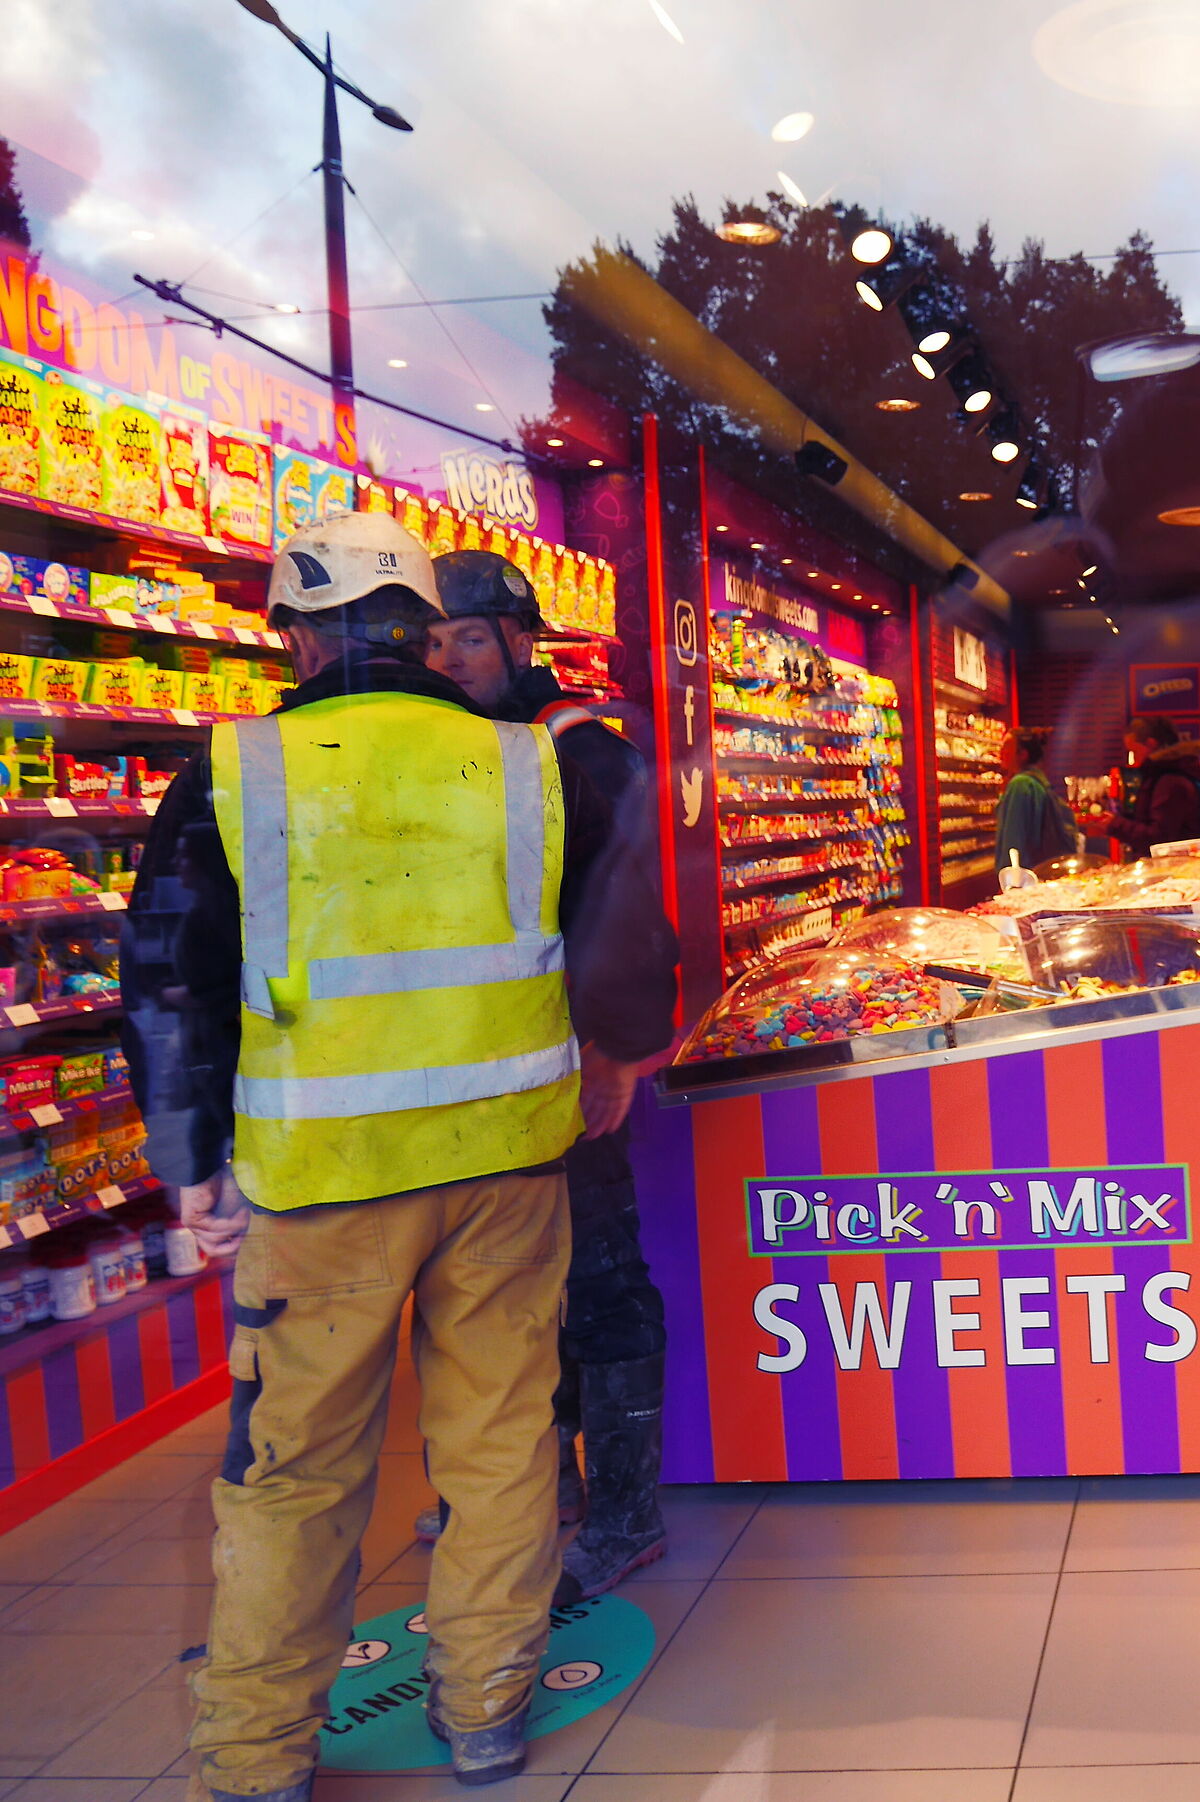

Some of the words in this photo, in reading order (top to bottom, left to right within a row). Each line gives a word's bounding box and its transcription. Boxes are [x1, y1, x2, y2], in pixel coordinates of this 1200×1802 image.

[180, 355, 211, 400] OF
[210, 352, 358, 466] SWEETS
[756, 1182, 929, 1246] Pick
[1027, 1177, 1178, 1238] Mix
[752, 1271, 1198, 1374] SWEETS
